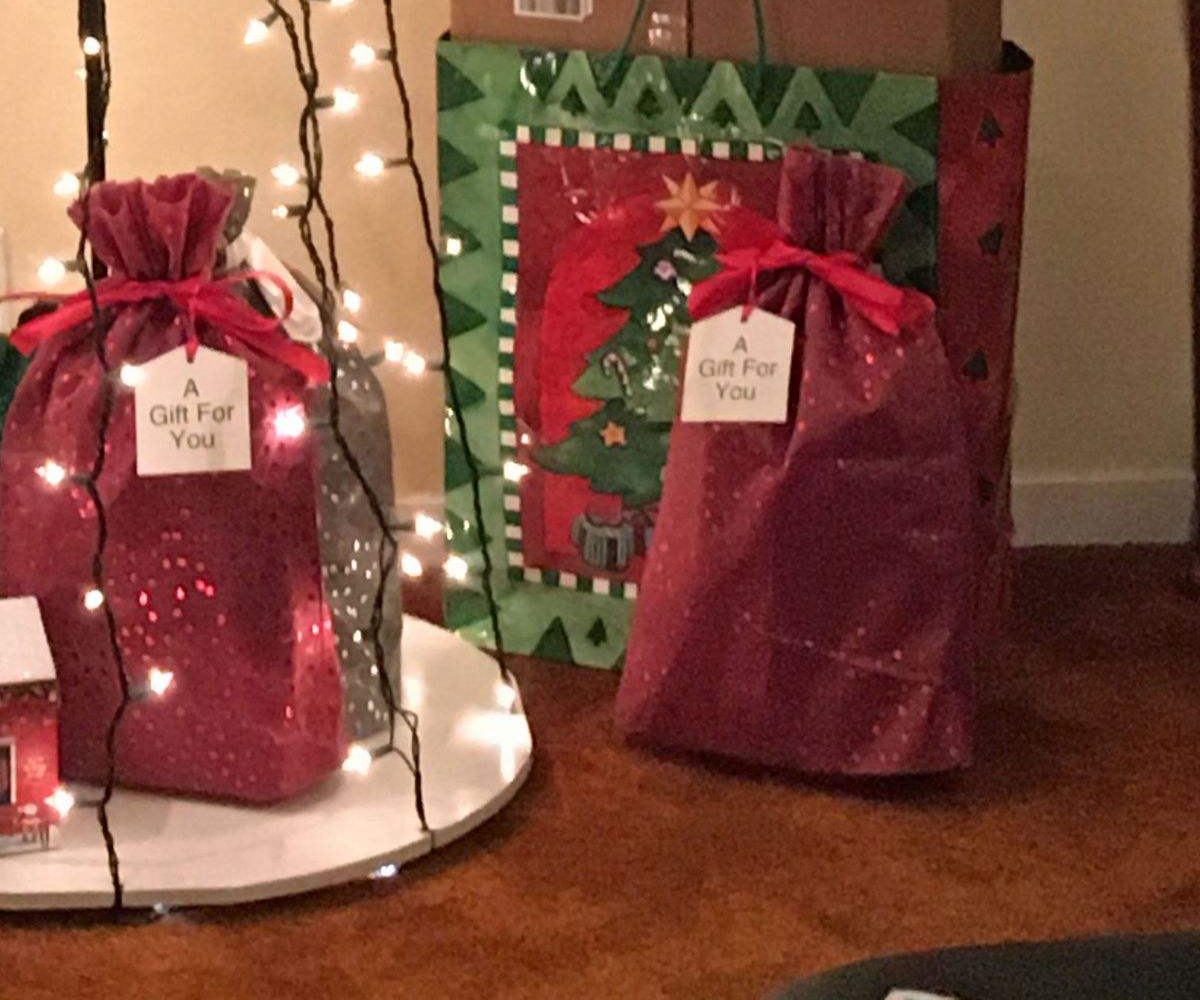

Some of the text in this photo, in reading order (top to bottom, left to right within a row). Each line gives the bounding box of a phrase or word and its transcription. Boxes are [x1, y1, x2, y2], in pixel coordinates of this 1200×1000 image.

[732, 336, 748, 353] A
[698, 358, 778, 378] Gift For
[183, 378, 199, 397] A
[715, 382, 756, 401] You
[149, 403, 235, 426] Gift For
[170, 430, 216, 449] You
